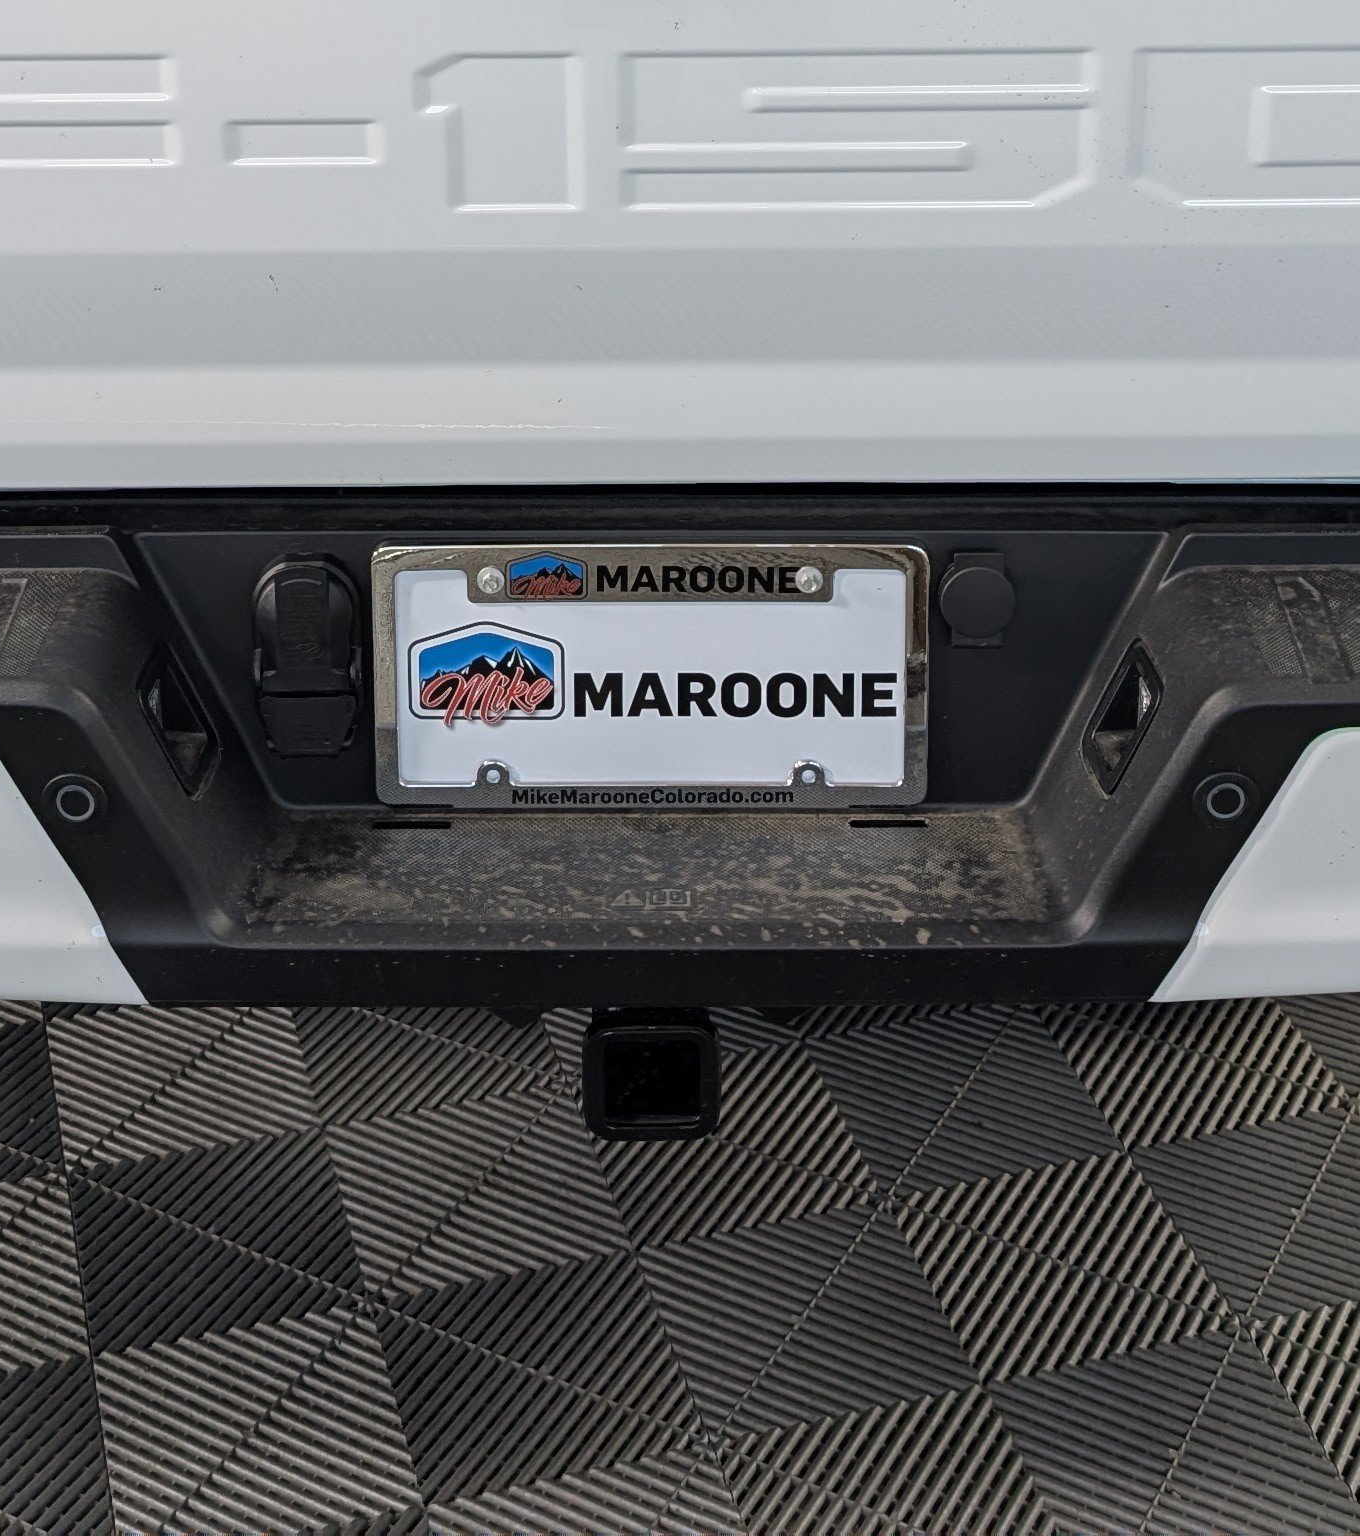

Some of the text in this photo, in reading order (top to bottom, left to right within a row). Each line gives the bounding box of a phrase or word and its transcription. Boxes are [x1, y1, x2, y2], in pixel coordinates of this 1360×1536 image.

[511, 565, 802, 601] Mike MAROONE
[421, 671, 897, 727] Mike MAROONE
[511, 787, 794, 805] MikeMarooneColorado.com
